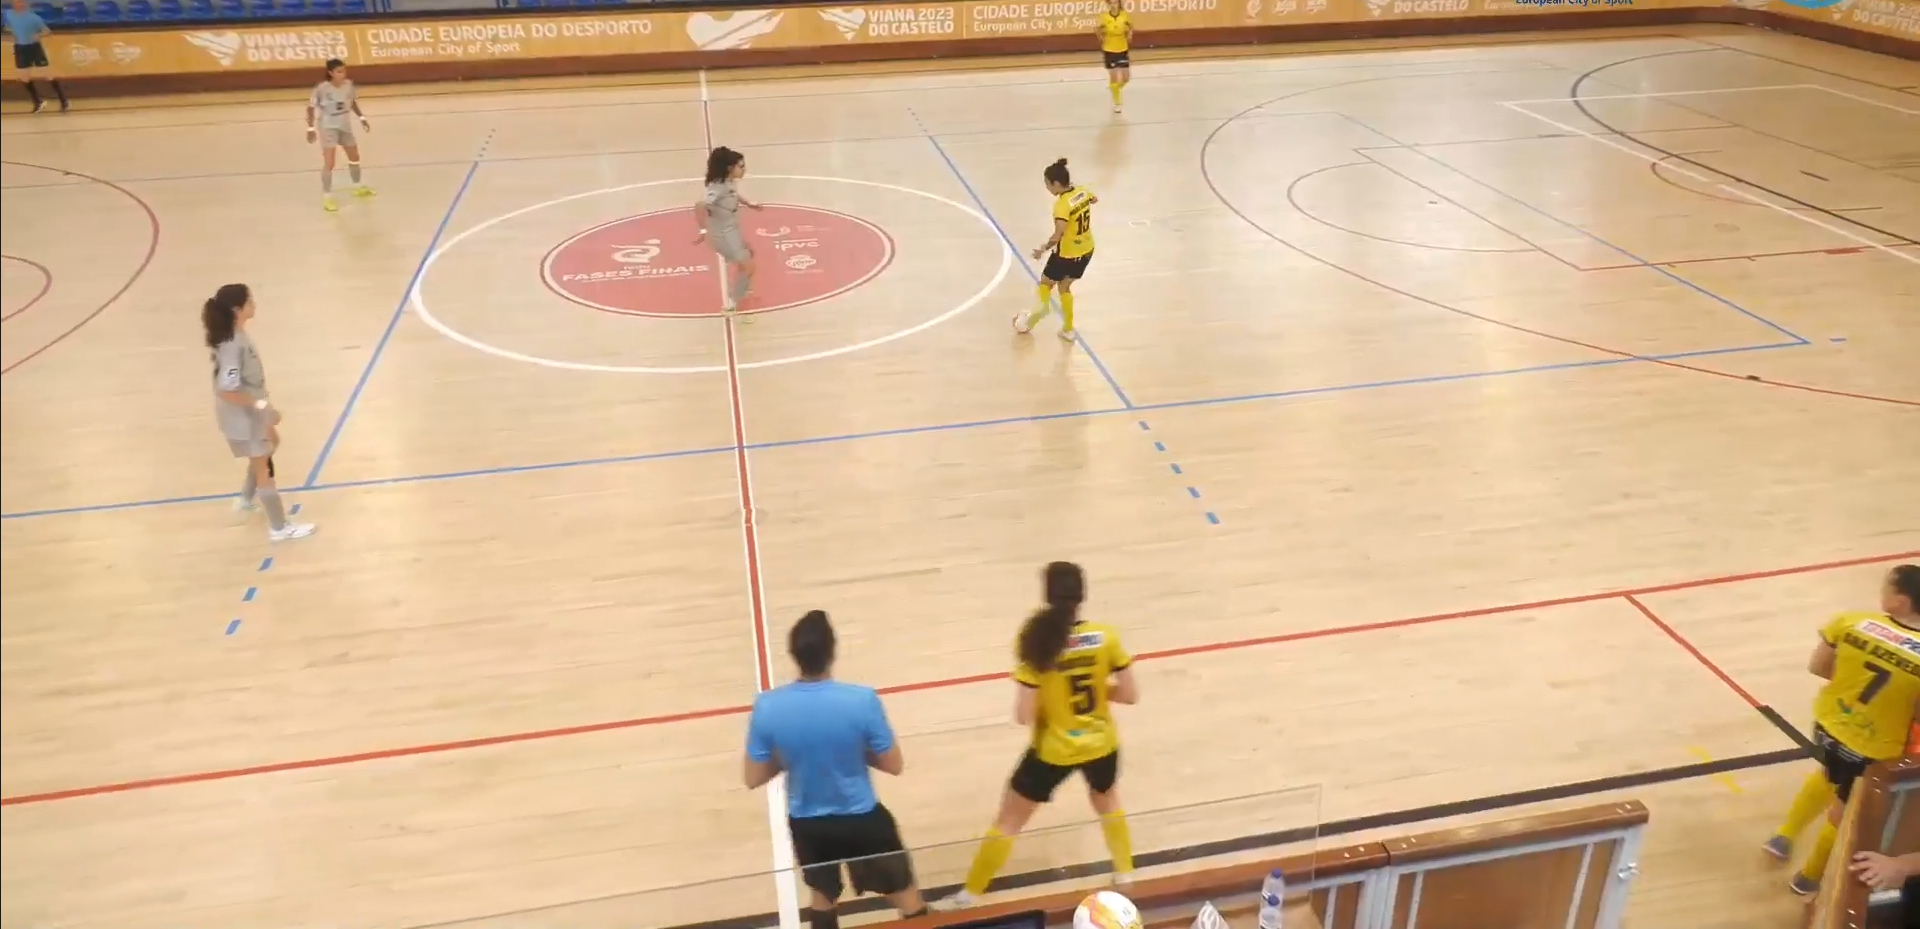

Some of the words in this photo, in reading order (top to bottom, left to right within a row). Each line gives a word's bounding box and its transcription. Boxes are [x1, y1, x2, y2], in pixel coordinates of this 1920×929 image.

[869, 10, 915, 23] VIANA
[918, 7, 954, 20] 2023
[974, 4, 1028, 20] CIDADE
[1140, 0, 1217, 12] DESPORTO
[367, 26, 434, 45] CIDADE
[439, 23, 526, 43] EUROPEIA
[532, 22, 557, 38] DO
[563, 19, 652, 37] DESPORTO
[869, 23, 888, 37] DO
[892, 21, 954, 35] CASTELO
[974, 20, 1026, 33] European
[1030, 18, 1054, 31] City
[1056, 17, 1070, 29] of
[243, 32, 301, 47] VIANA
[302, 29, 345, 45] 2023
[247, 48, 272, 62] DO
[274, 44, 348, 61] CASTELO
[371, 46, 432, 58] European
[438, 43, 463, 56] City
[468, 42, 481, 53] of
[486, 41, 521, 55] Sport
[1075, 209, 1090, 236] 15
[562, 270, 632, 281] FASES
[638, 264, 709, 276] FINAIS
[1858, 660, 1892, 706] 7
[1070, 674, 1096, 715] 5
